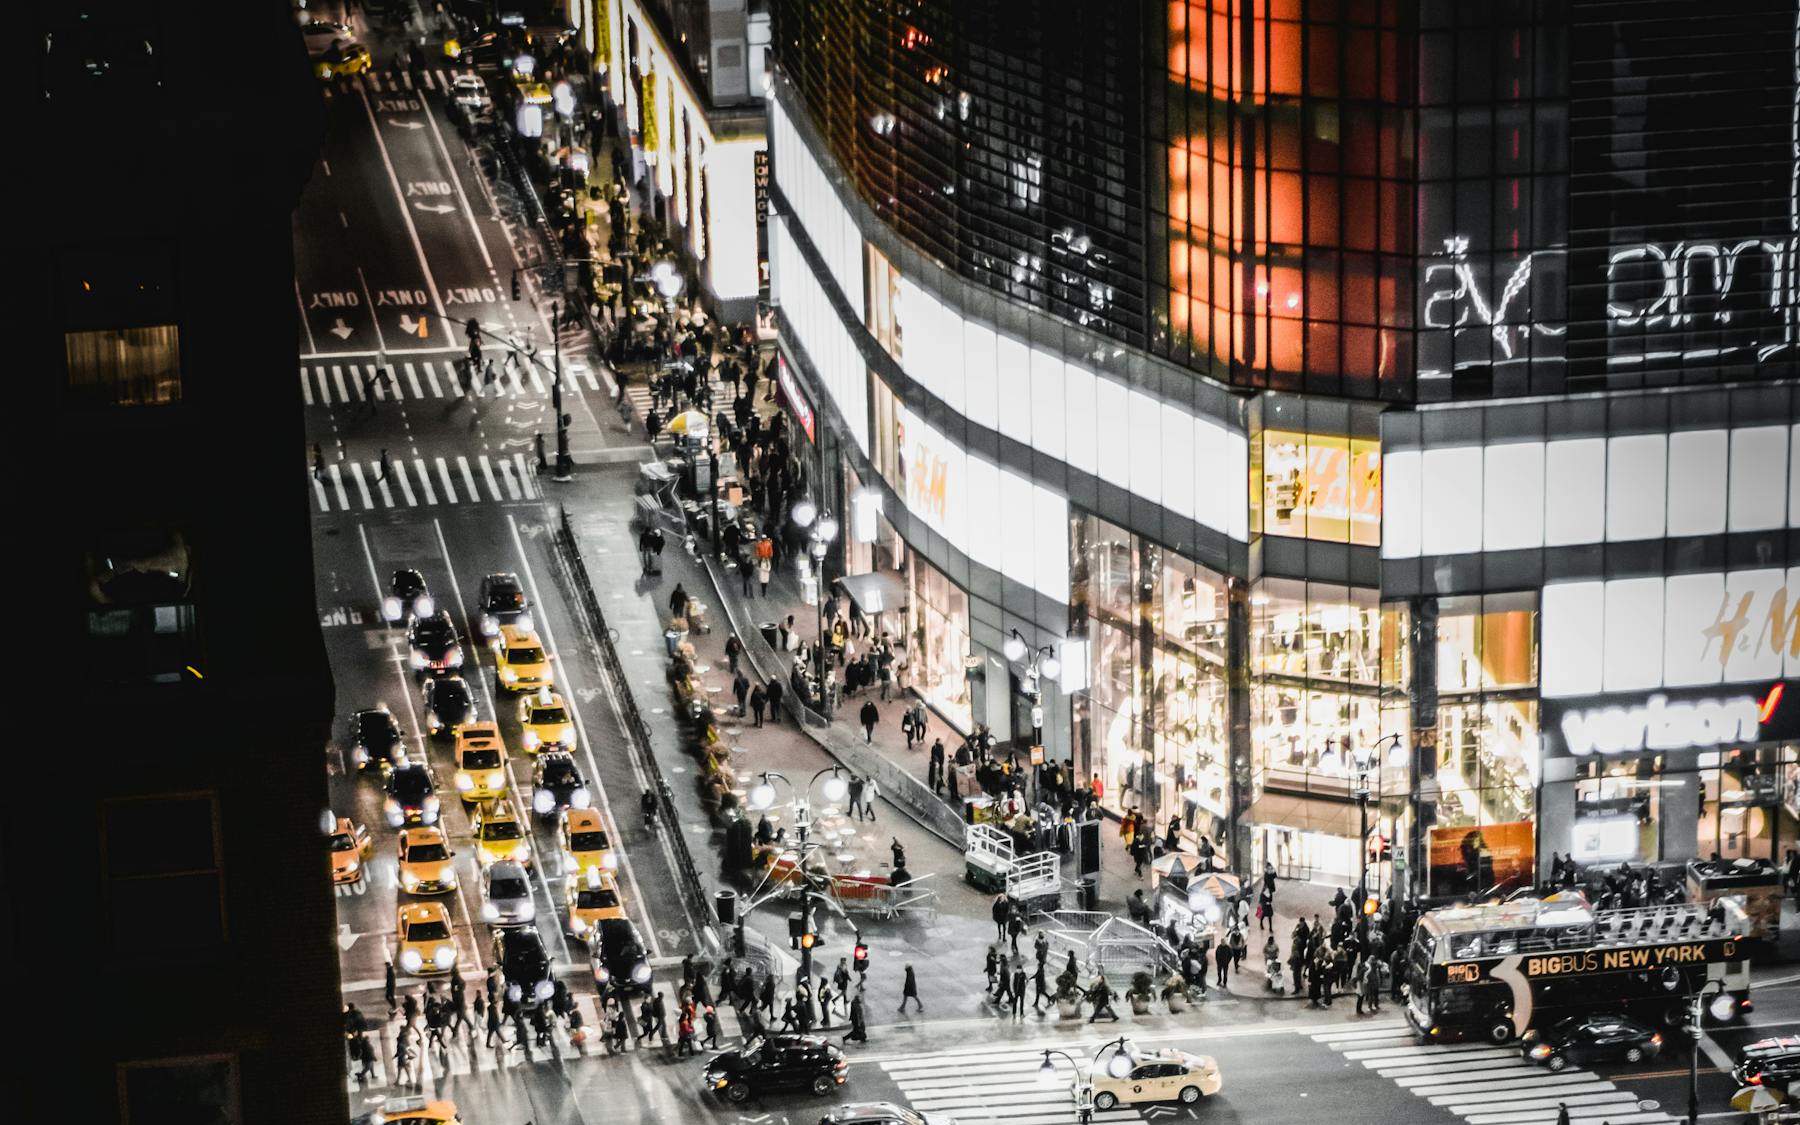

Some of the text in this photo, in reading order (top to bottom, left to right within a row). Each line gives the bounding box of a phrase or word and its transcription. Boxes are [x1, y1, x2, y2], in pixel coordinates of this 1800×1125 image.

[376, 99, 421, 112] ONLY
[405, 181, 452, 197] ONLY
[309, 291, 359, 309] ONLY
[375, 289, 428, 306] ONLY
[444, 286, 497, 305] ONLY
[1562, 695, 1759, 754] verizon
[1528, 944, 1706, 976] BIGBUS NEW YORK
[1447, 965, 1465, 976] BIG
